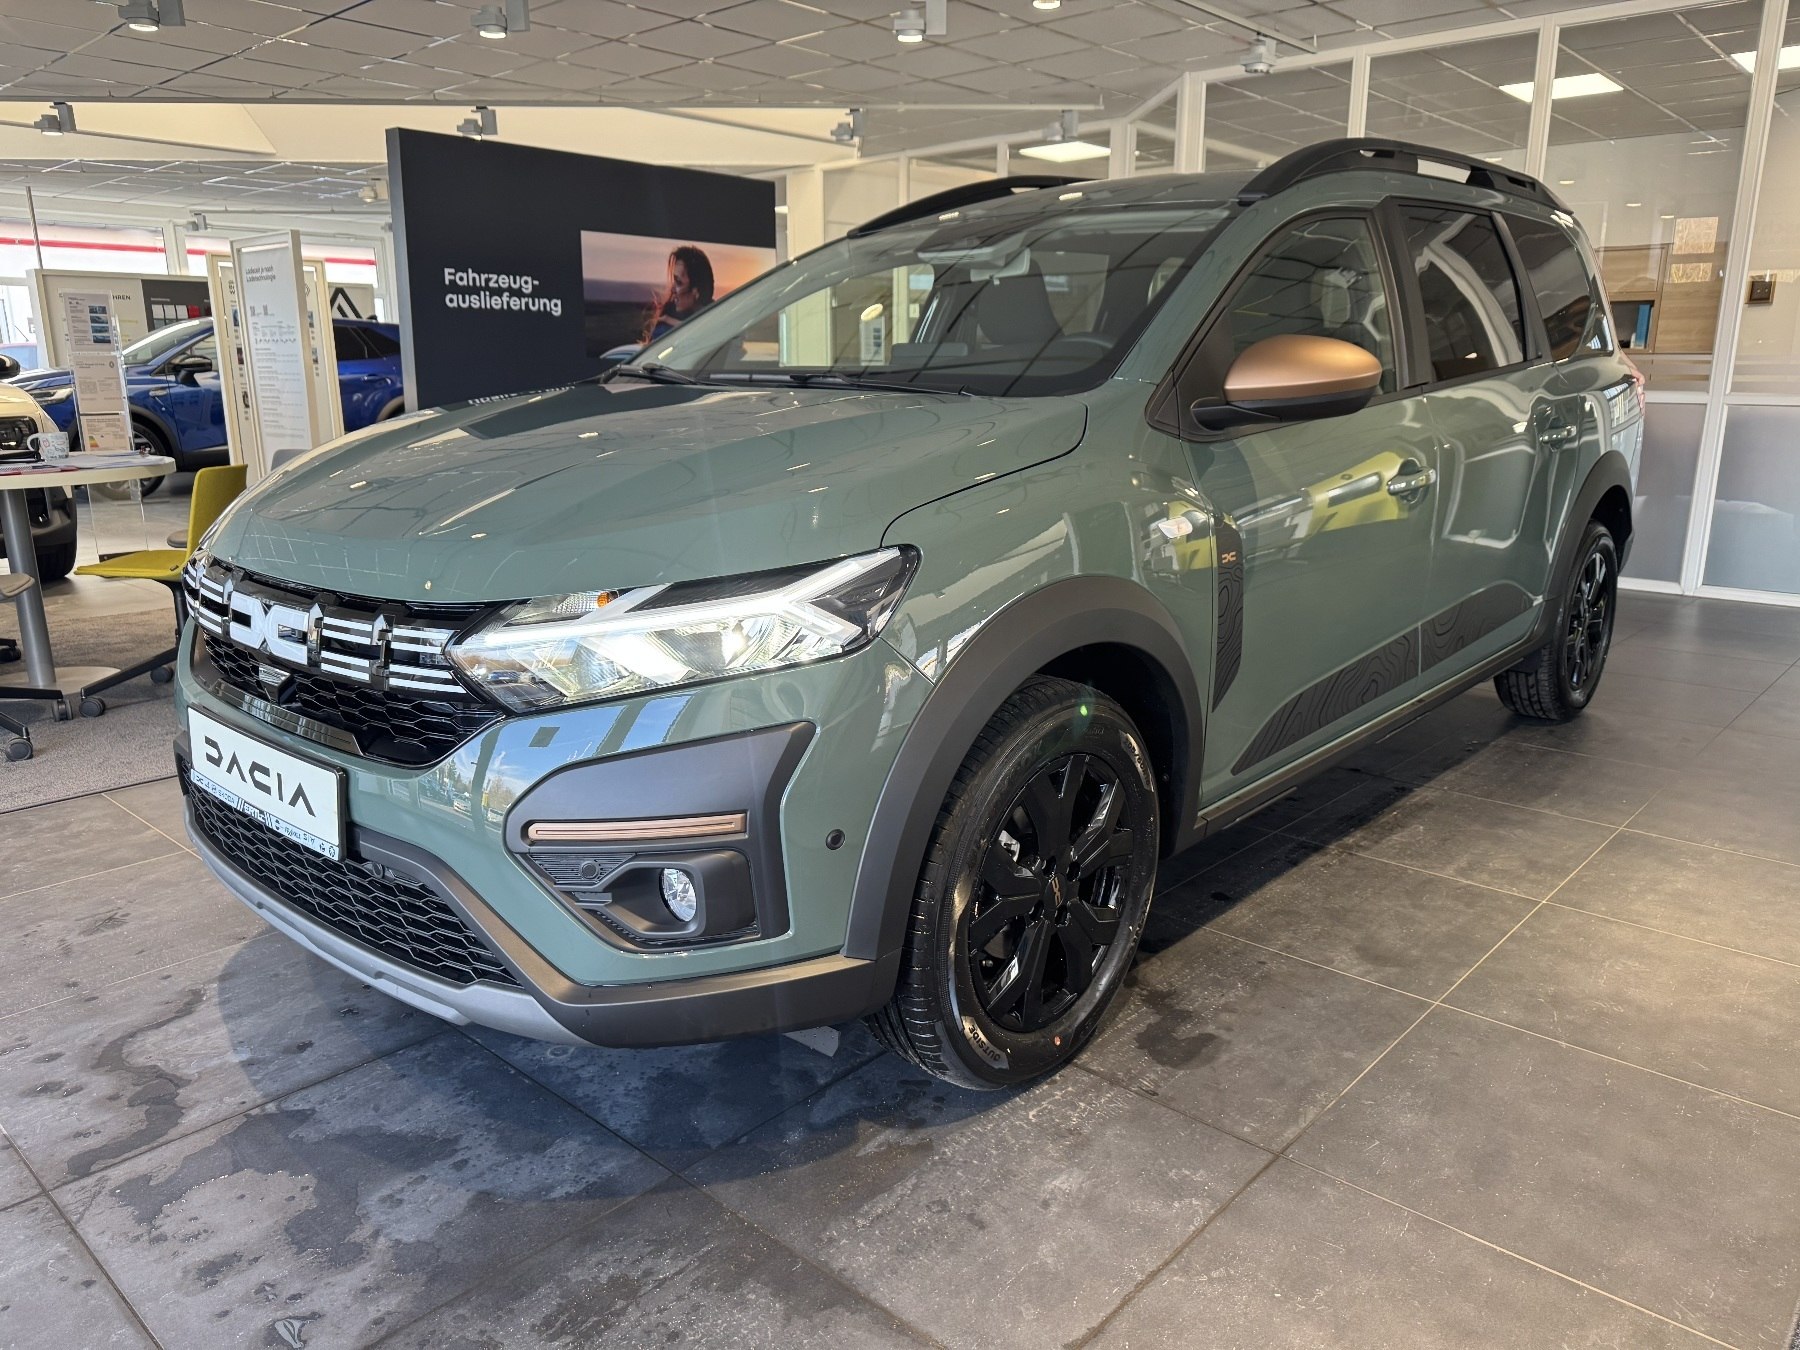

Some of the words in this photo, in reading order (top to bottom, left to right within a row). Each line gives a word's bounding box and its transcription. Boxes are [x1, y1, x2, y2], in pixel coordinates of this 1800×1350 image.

[443, 267, 540, 294] Fahrzeug-
[445, 290, 562, 317] auslieferung
[204, 735, 316, 818] DACIA
[968, 1024, 1001, 1062] OUTSIDE
